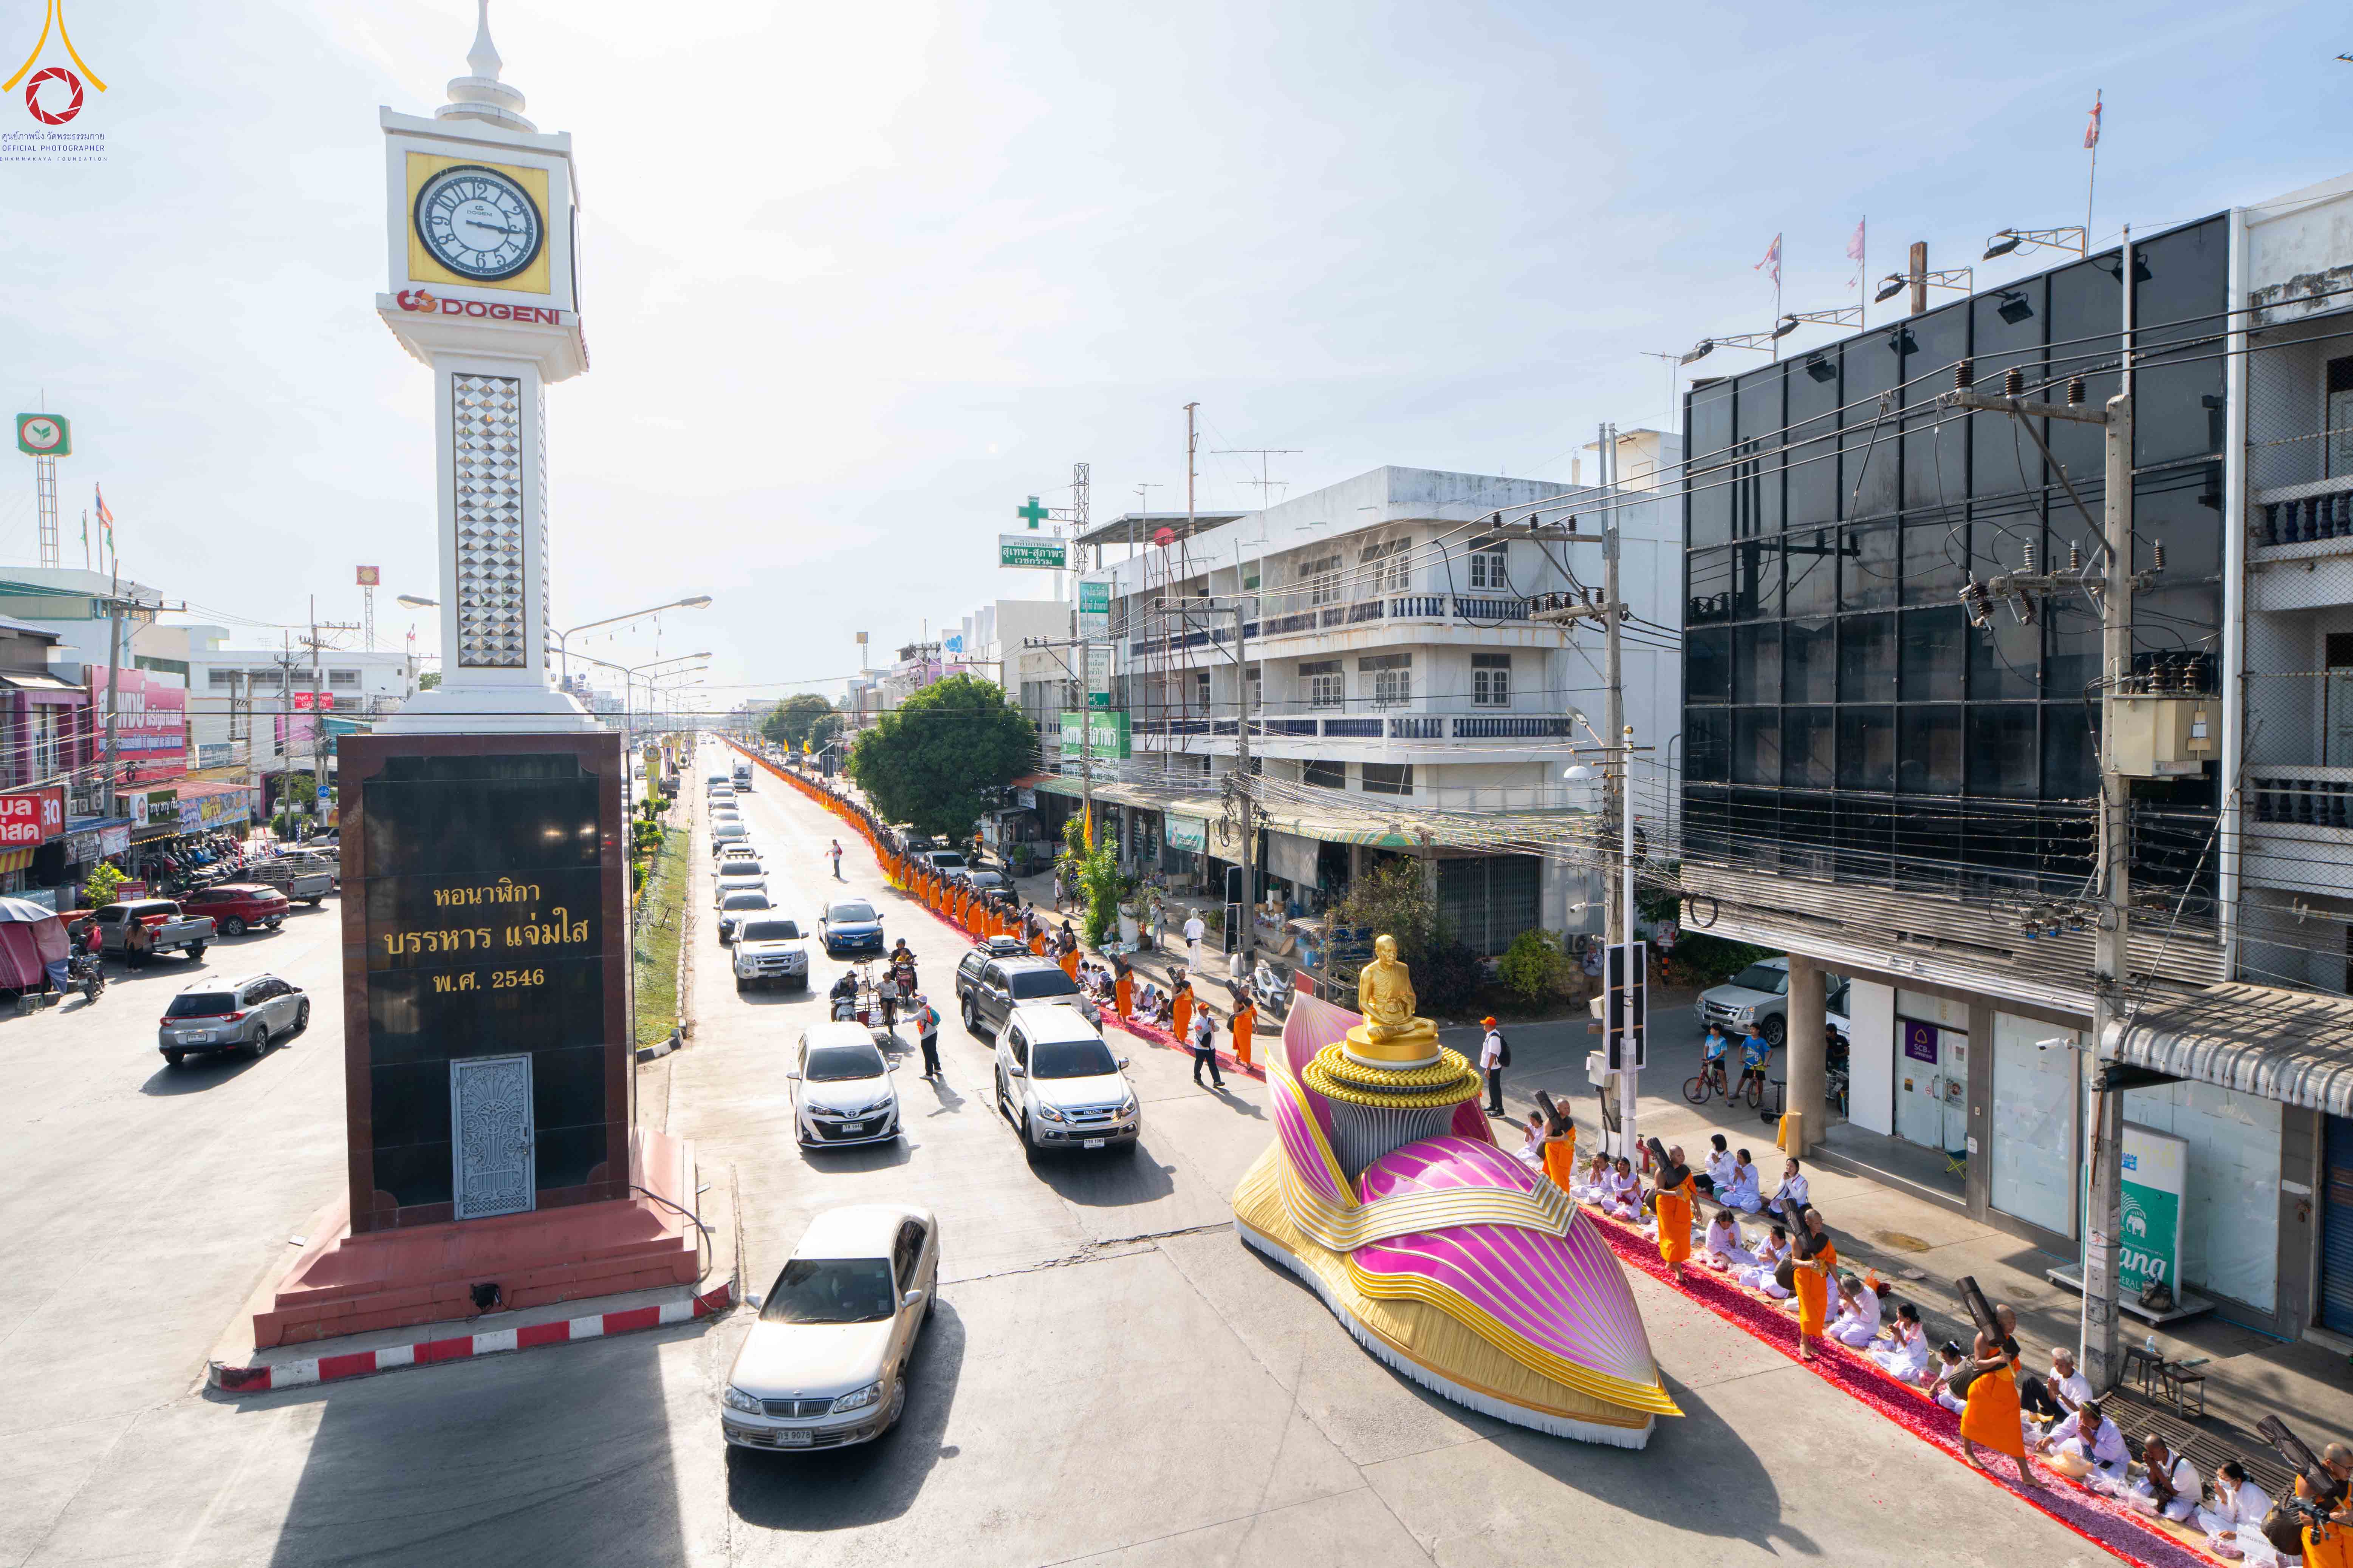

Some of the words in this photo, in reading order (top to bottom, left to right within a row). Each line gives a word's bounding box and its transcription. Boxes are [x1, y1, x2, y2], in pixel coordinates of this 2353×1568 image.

[450, 184, 469, 201] 11
[472, 183, 488, 200] 12
[493, 190, 505, 206] 1
[435, 195, 456, 211] 10
[432, 215, 450, 226] 9
[504, 206, 521, 219] 2
[437, 233, 455, 245] 8
[506, 240, 522, 254] 4
[454, 246, 470, 261] 7
[475, 252, 486, 269] 6
[493, 249, 507, 266] 5
[441, 298, 560, 325] DOGENI
[1003, 547, 1064, 560] สุเทพ-สุภาพร
[98, 679, 145, 728] สพงษ์
[433, 877, 540, 906] หอนาฬิกา
[384, 926, 492, 954] บรรหาร
[506, 908, 590, 947] แจ่มใส
[433, 970, 481, 993] พ.ศ.
[492, 969, 545, 988] 2546
[1914, 1043, 1927, 1053] SCB
